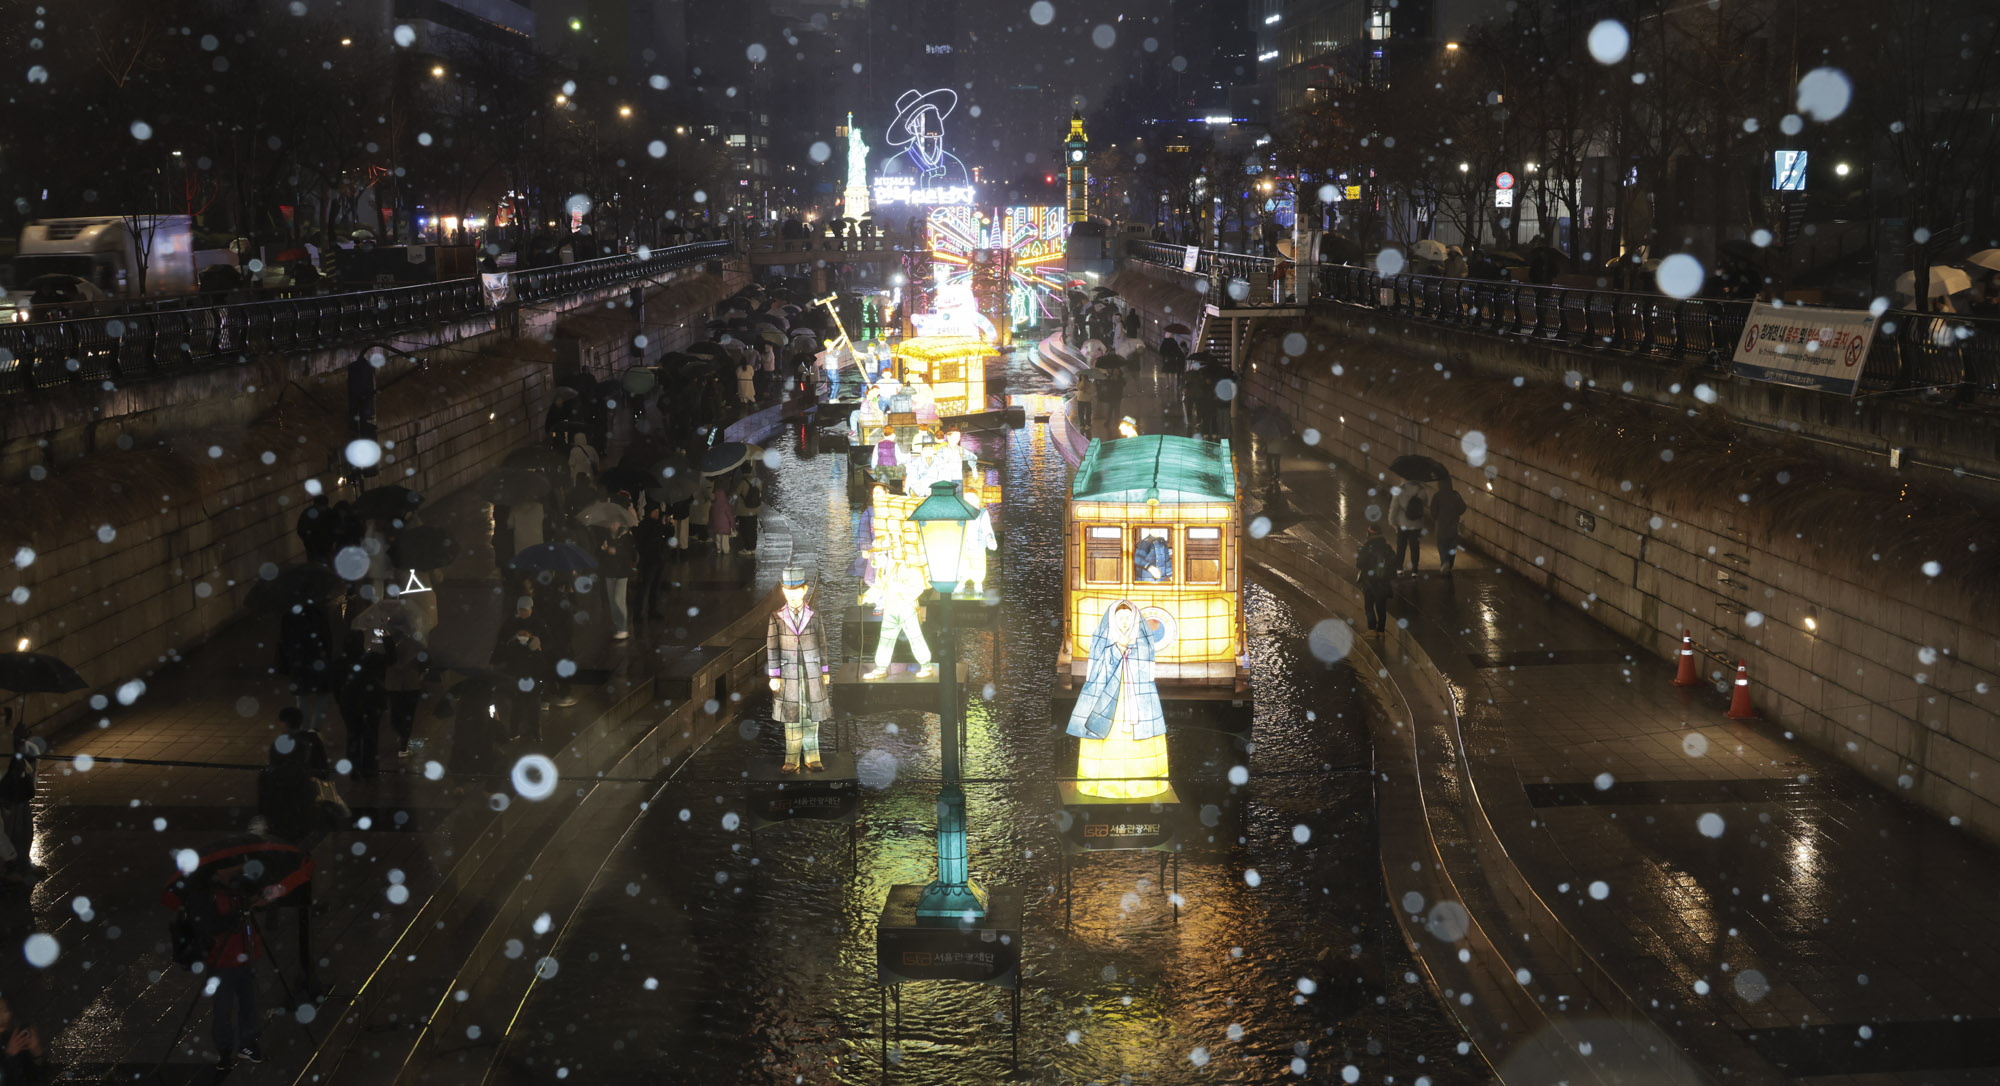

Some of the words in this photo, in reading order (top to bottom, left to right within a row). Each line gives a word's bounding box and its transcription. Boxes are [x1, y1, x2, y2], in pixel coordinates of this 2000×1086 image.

[1785, 153, 1797, 169] P
[874, 176, 916, 186] MUSICAL
[1760, 324, 1780, 341] 청계천
[1779, 326, 1787, 342] 내
[1785, 327, 1800, 343] 음주
[1798, 328, 1808, 344] 및
[1833, 332, 1850, 348] 금지
[1110, 824, 1160, 834] 서울관광재단
[934, 952, 994, 963] 서울관광재단
